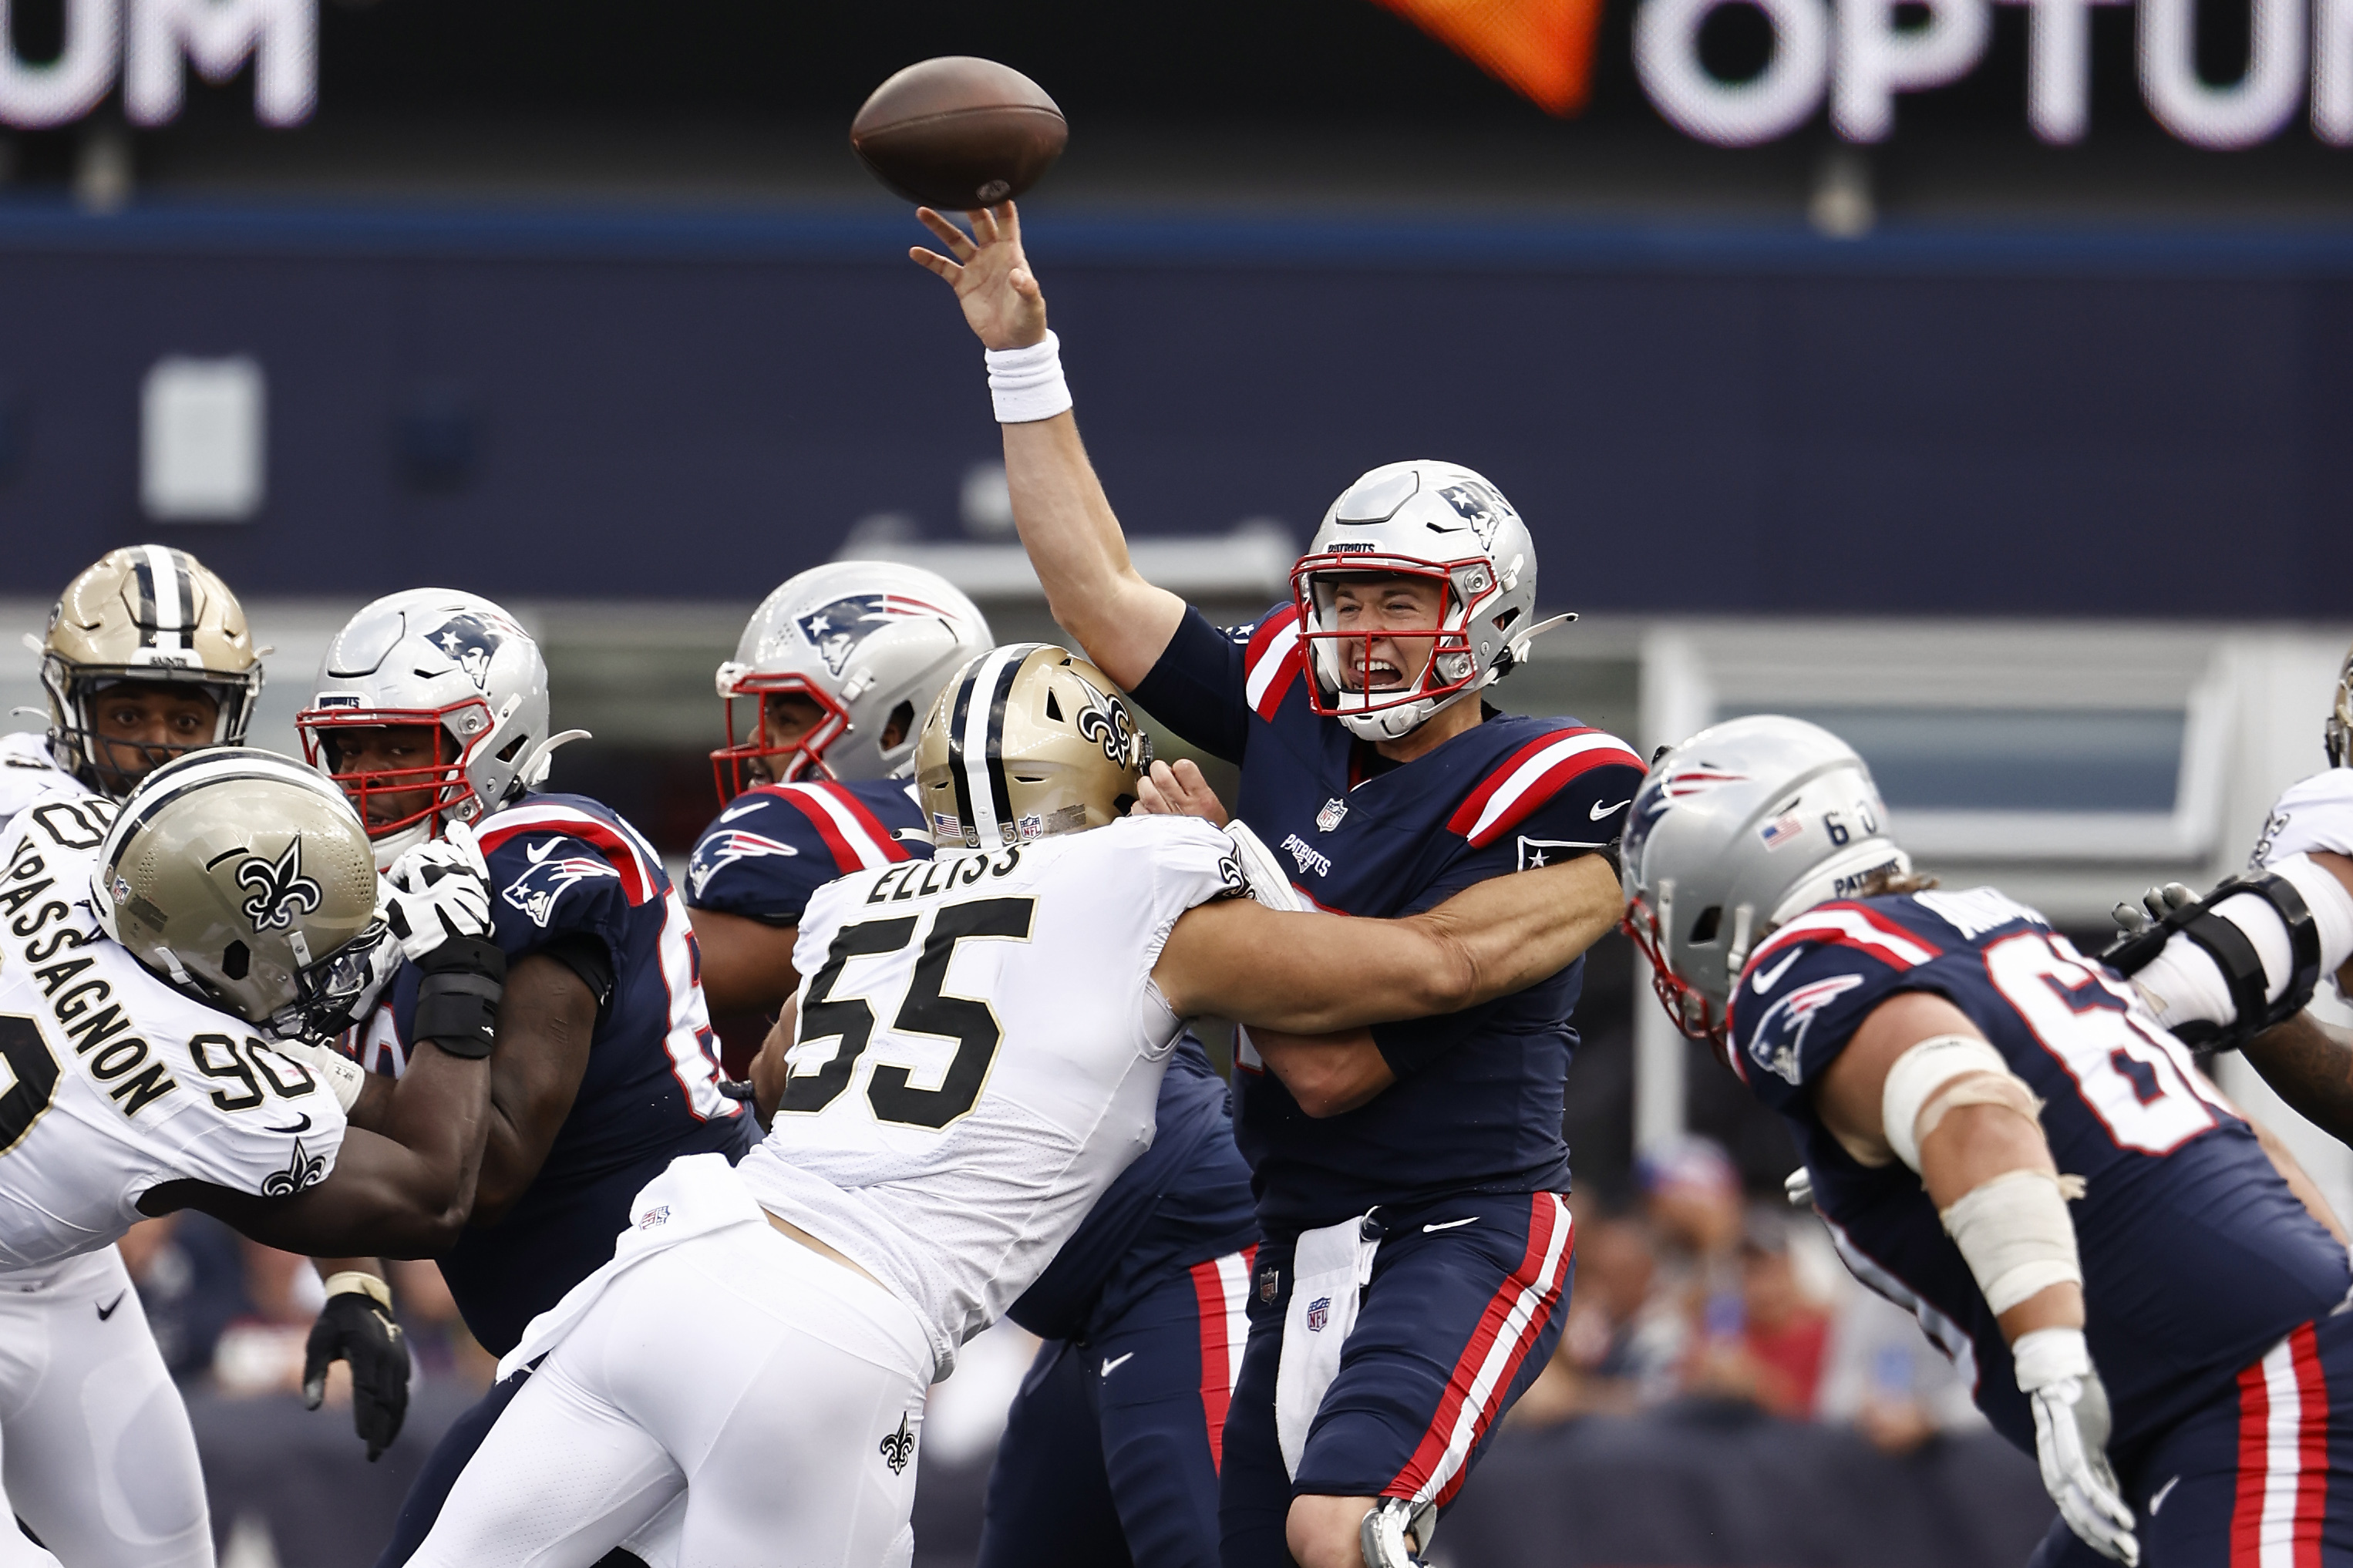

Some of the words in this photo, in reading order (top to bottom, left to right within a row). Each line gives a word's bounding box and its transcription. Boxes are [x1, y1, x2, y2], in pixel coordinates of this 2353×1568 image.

[1328, 543, 1375, 553] PATRIOTS
[1321, 809, 1337, 827] NFL
[1023, 824, 1041, 836] NFL
[1280, 833, 1331, 877] PATRIOTS
[773, 894, 1041, 1134] 55
[188, 1031, 315, 1112] 90
[1308, 1309, 1327, 1328] NFL
